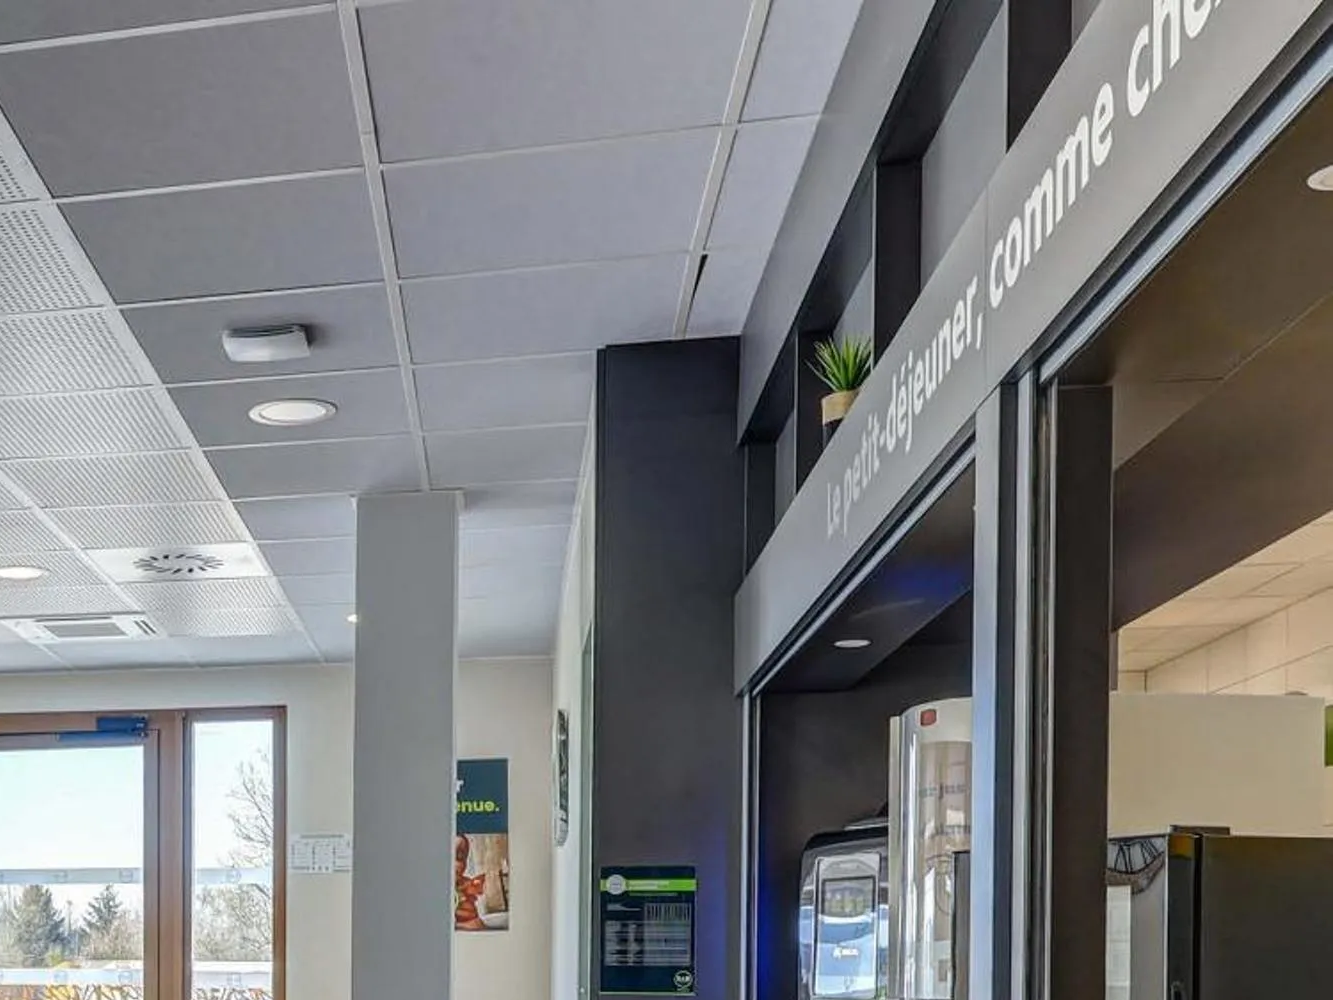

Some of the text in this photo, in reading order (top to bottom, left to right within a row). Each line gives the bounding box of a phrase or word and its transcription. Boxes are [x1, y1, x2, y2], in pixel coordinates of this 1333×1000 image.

[827, 0, 1222, 539] Le petit-déjeuner, comme ch
